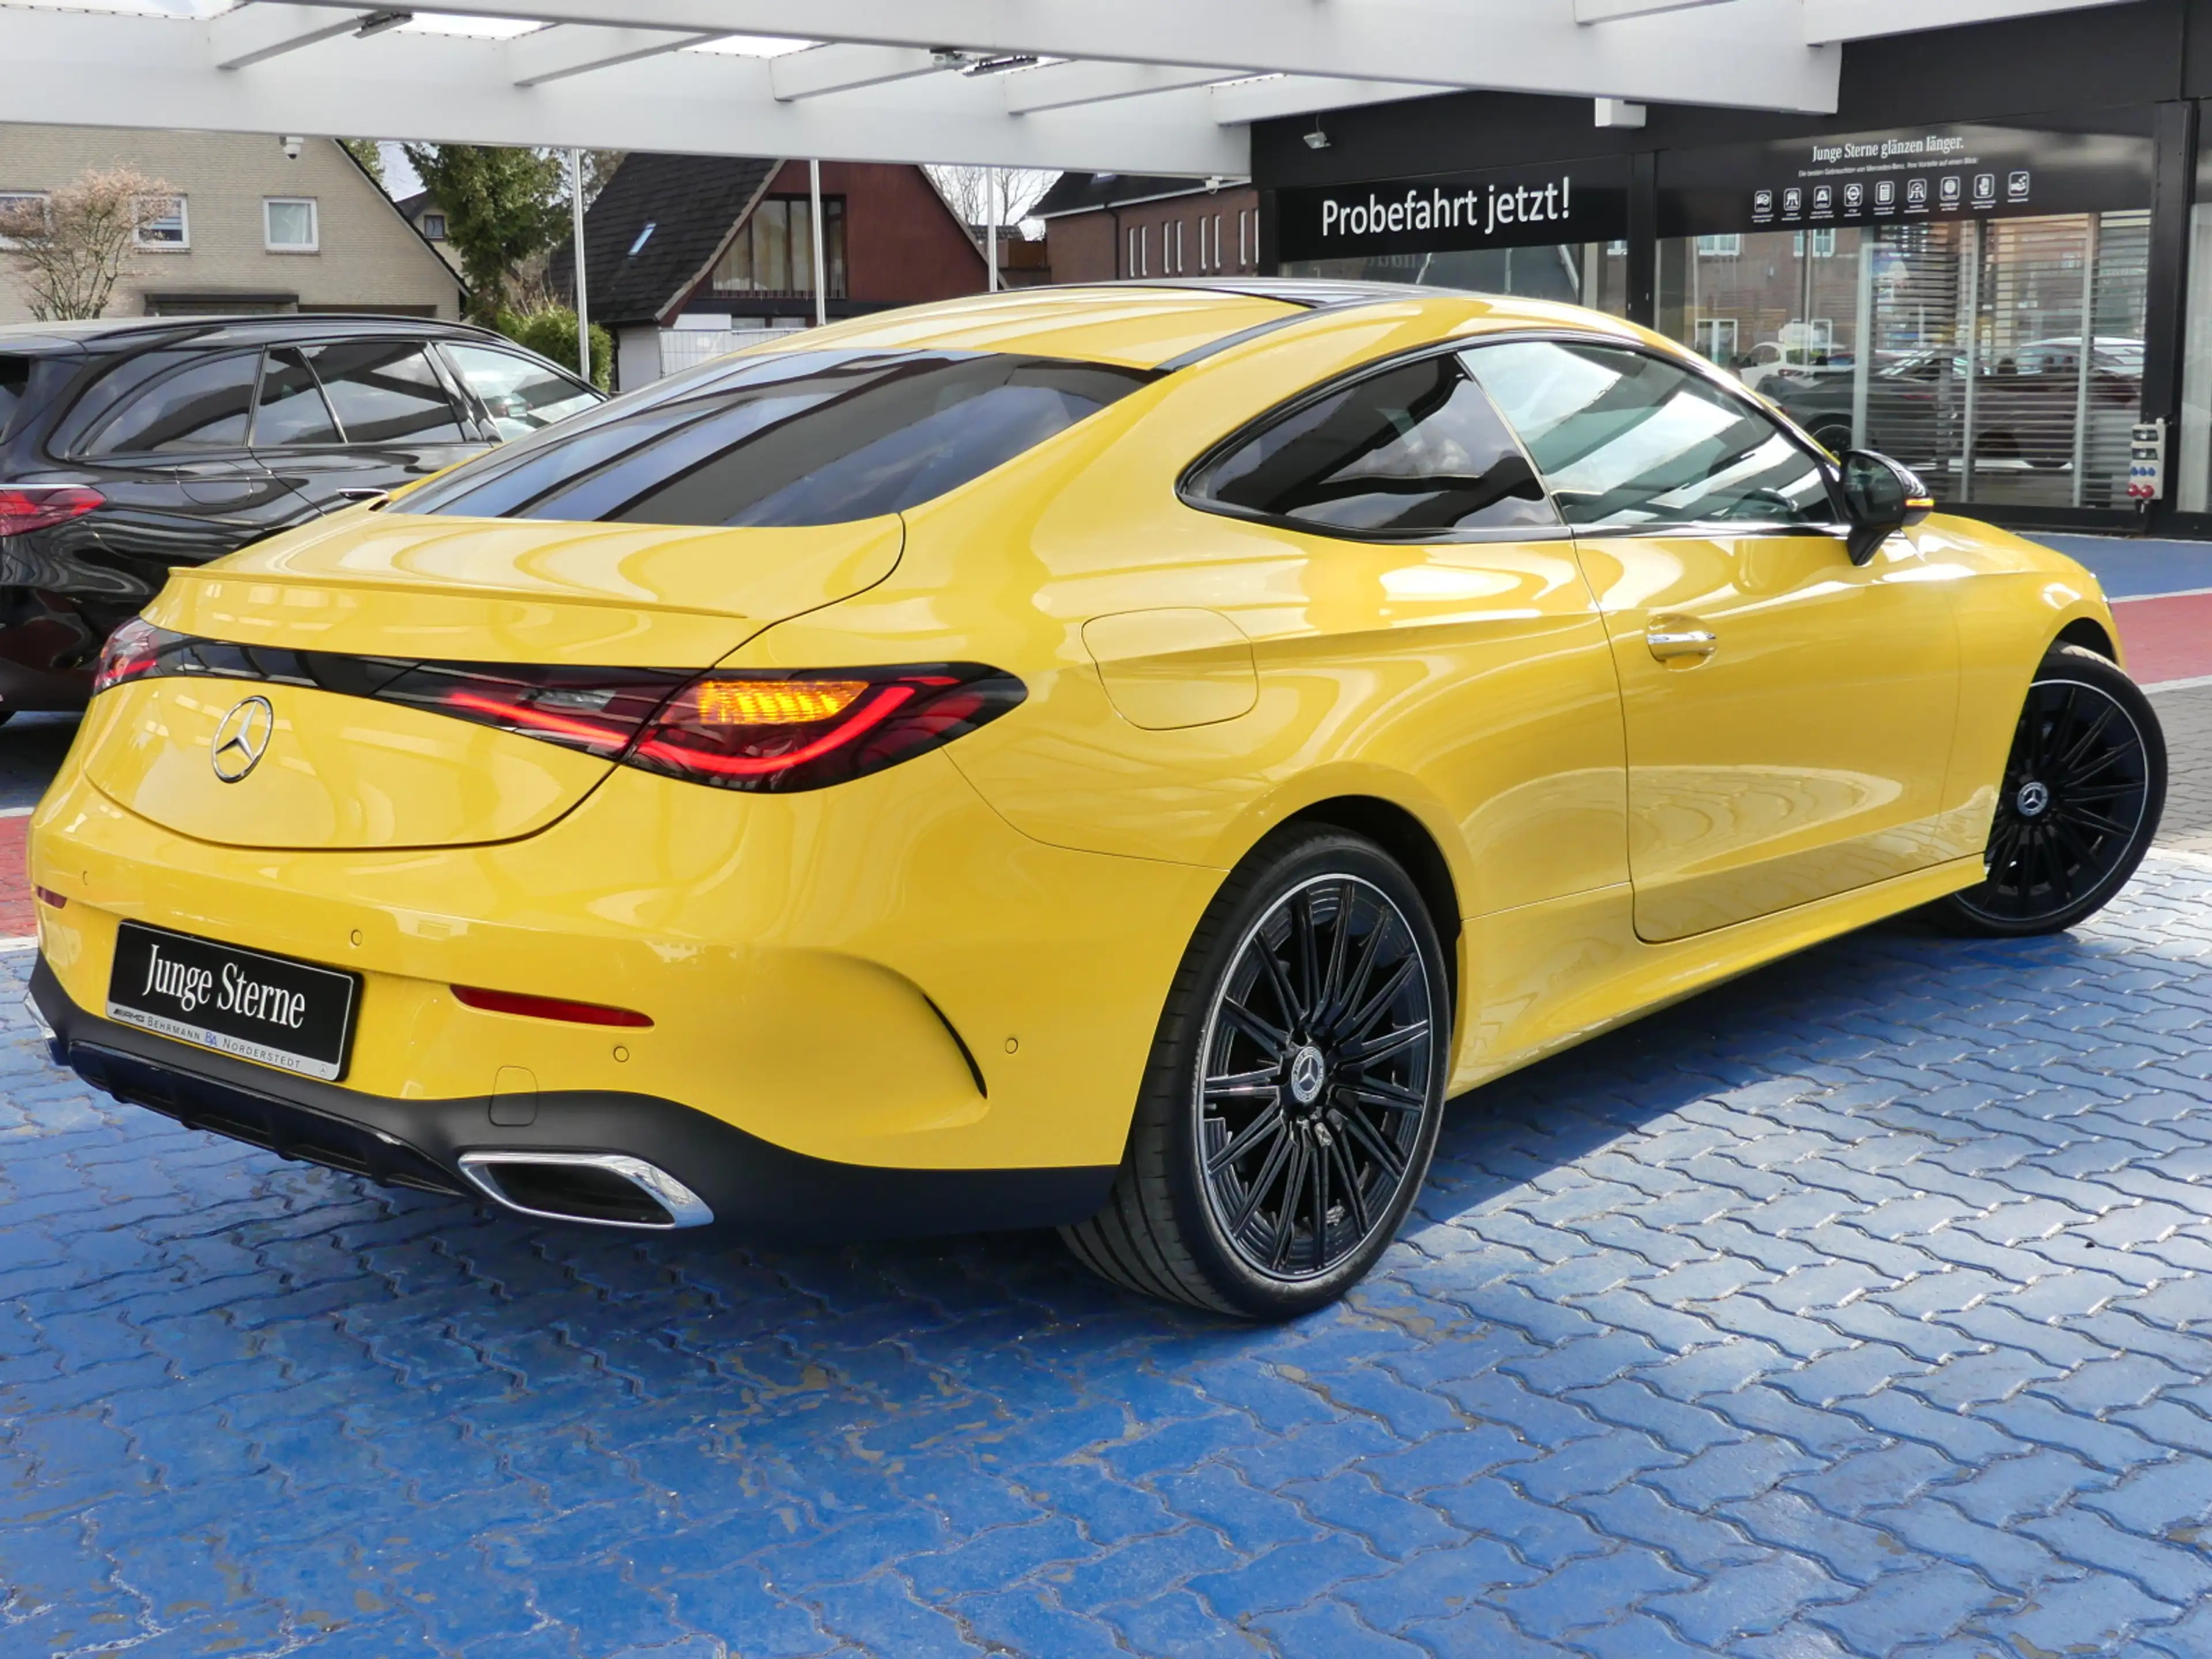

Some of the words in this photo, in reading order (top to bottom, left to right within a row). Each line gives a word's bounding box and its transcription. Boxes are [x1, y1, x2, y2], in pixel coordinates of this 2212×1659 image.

[1812, 145, 1842, 163] Junge
[1844, 143, 1879, 158] Sterne
[1880, 138, 1923, 158] glänzen
[1926, 135, 1965, 154] länger.
[1323, 187, 1478, 237] Probefahrt
[1484, 175, 1570, 235] jetzt!
[142, 944, 213, 1012] Junge
[216, 962, 306, 1029] Sterne
[147, 1016, 200, 1041] BEHRMANN
[222, 1037, 301, 1069] NORDERSTEDT
